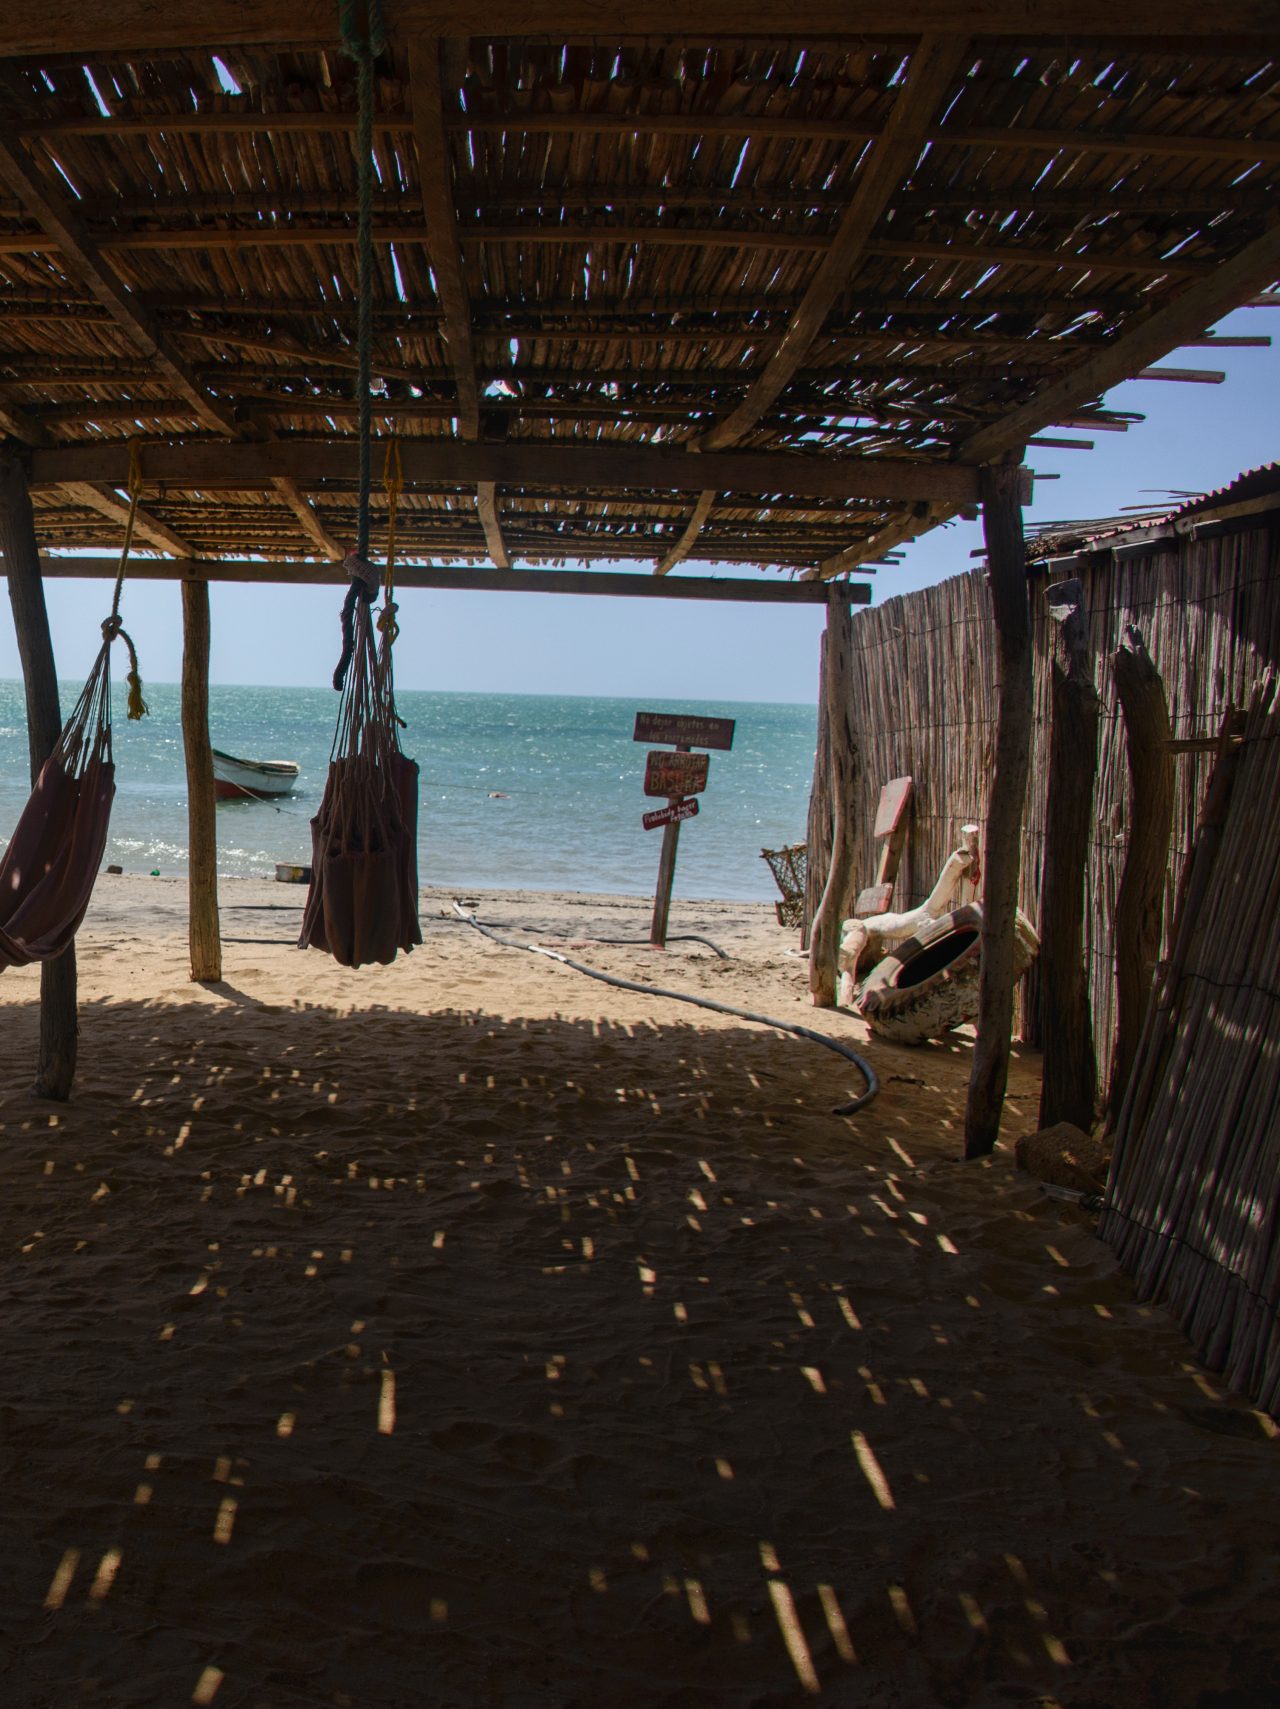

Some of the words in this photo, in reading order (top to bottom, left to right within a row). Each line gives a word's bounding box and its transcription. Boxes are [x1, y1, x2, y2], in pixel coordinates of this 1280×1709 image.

[653, 714, 672, 729] dejar
[650, 752, 665, 768] NO
[669, 753, 706, 771] ARROJAR
[650, 770, 701, 793] BASURA
